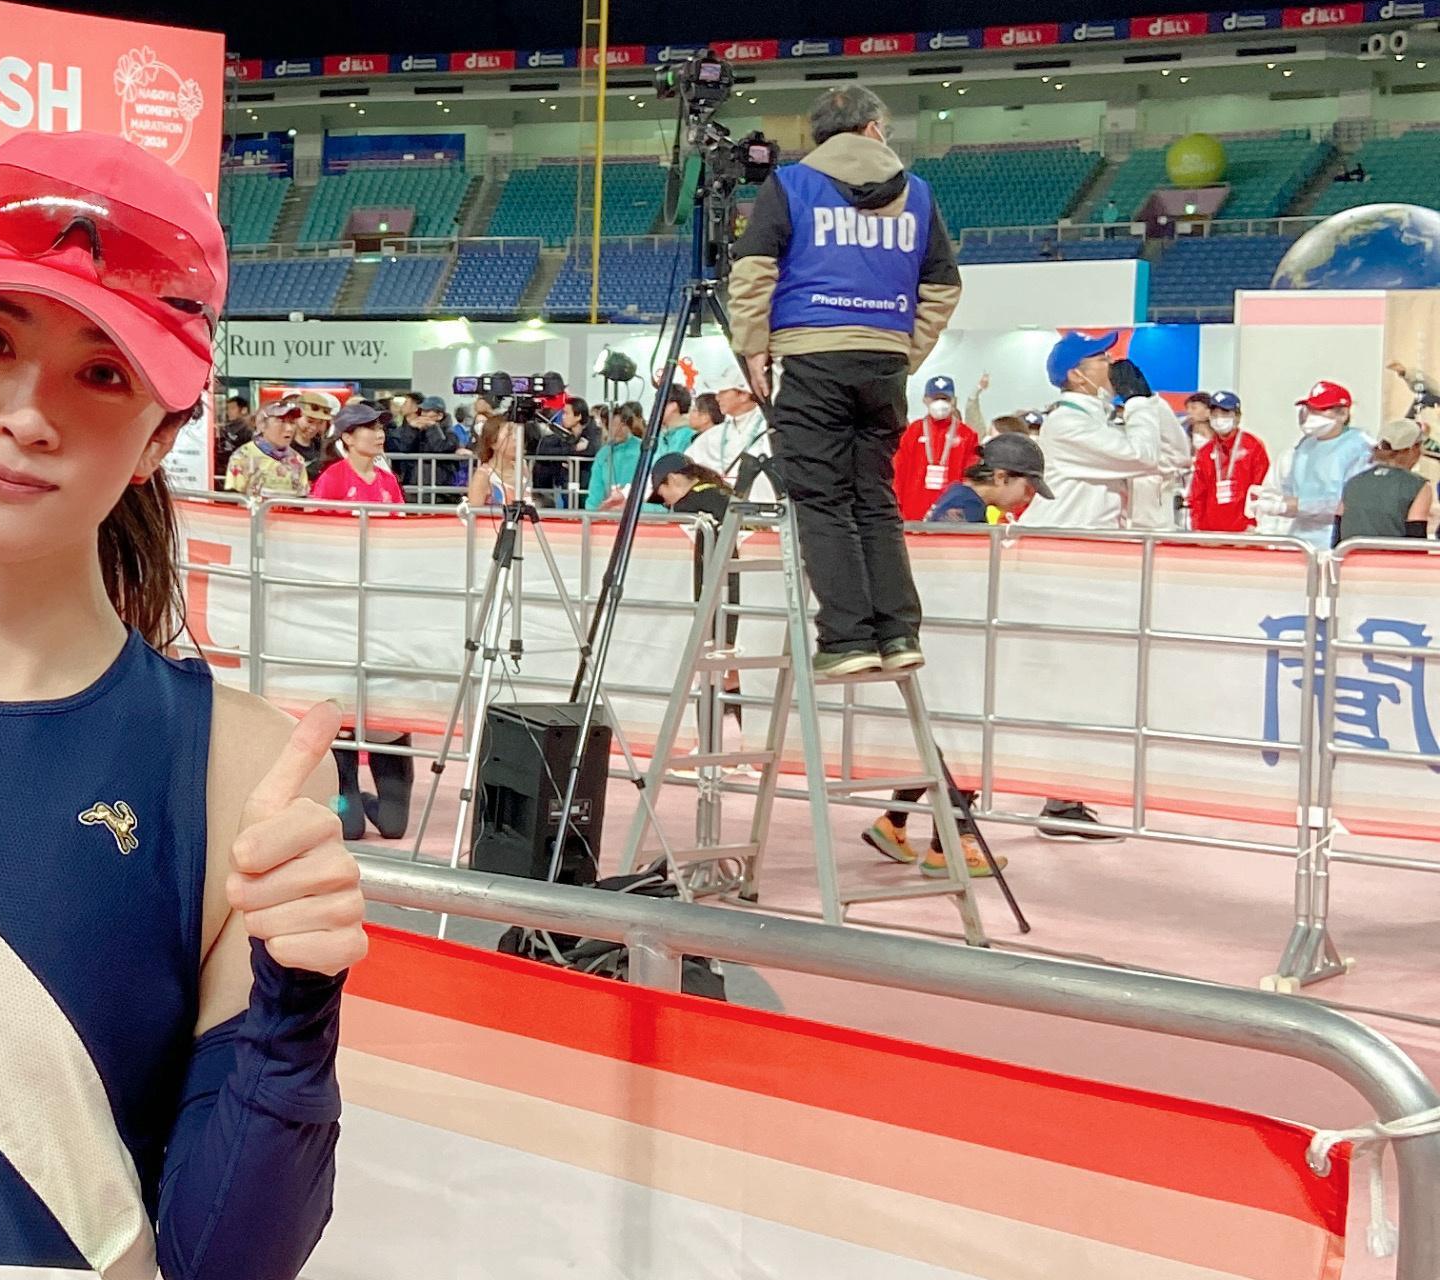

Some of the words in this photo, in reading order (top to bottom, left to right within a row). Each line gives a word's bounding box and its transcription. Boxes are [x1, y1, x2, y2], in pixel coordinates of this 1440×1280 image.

[138, 87, 177, 102] NAGOYA
[130, 118, 184, 134] MARATHON
[143, 135, 169, 149] 2024
[813, 206, 916, 253] PHOTO
[229, 334, 276, 357] Run
[283, 338, 335, 364] your
[342, 338, 388, 365] way.
